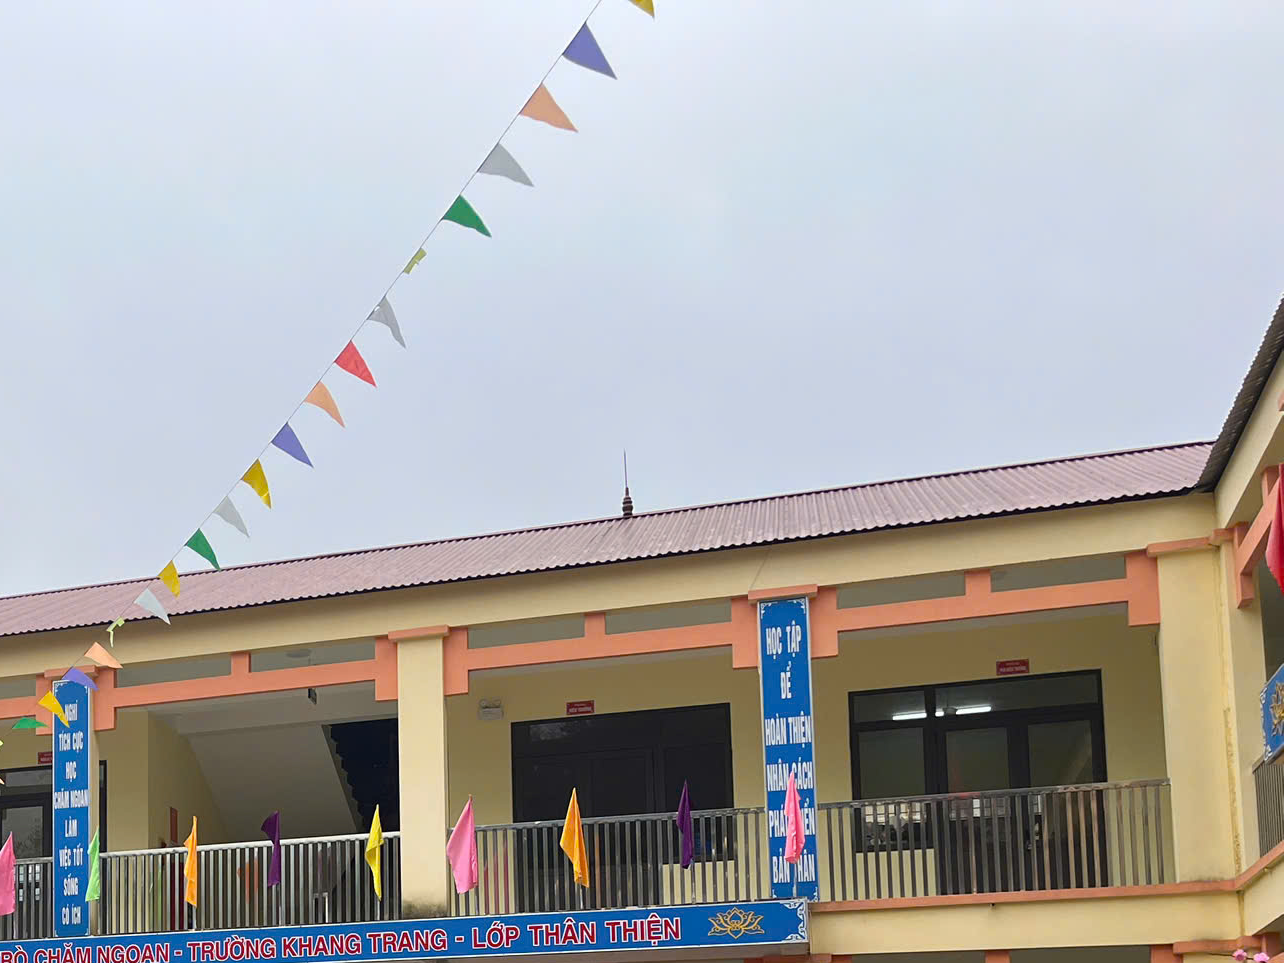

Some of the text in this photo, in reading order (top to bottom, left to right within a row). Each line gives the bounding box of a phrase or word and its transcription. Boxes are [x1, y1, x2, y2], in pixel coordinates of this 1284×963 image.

[765, 620, 802, 660] HỌC TẬP
[780, 661, 792, 699] ĐỂ
[58, 730, 84, 753] TÍCH CỰC
[764, 710, 812, 748] HOÀN THIỆN
[65, 761, 77, 783] HỌC
[766, 758, 789, 792] NHÂN
[70, 789, 89, 809] NGOAN
[64, 815, 78, 838] LÀM
[59, 842, 84, 870] VIỆC TỐT
[797, 849, 816, 883] HÂN
[63, 873, 79, 896] SỐNG
[61, 904, 82, 925] CÓ ÍCH
[187, 934, 276, 962] TRƯỜNG
[282, 933, 362, 958] KHANG
[367, 929, 447, 954] TRANG
[471, 919, 520, 948] LỚP
[527, 916, 599, 945] THÂN
[604, 912, 681, 946] THIỆN
